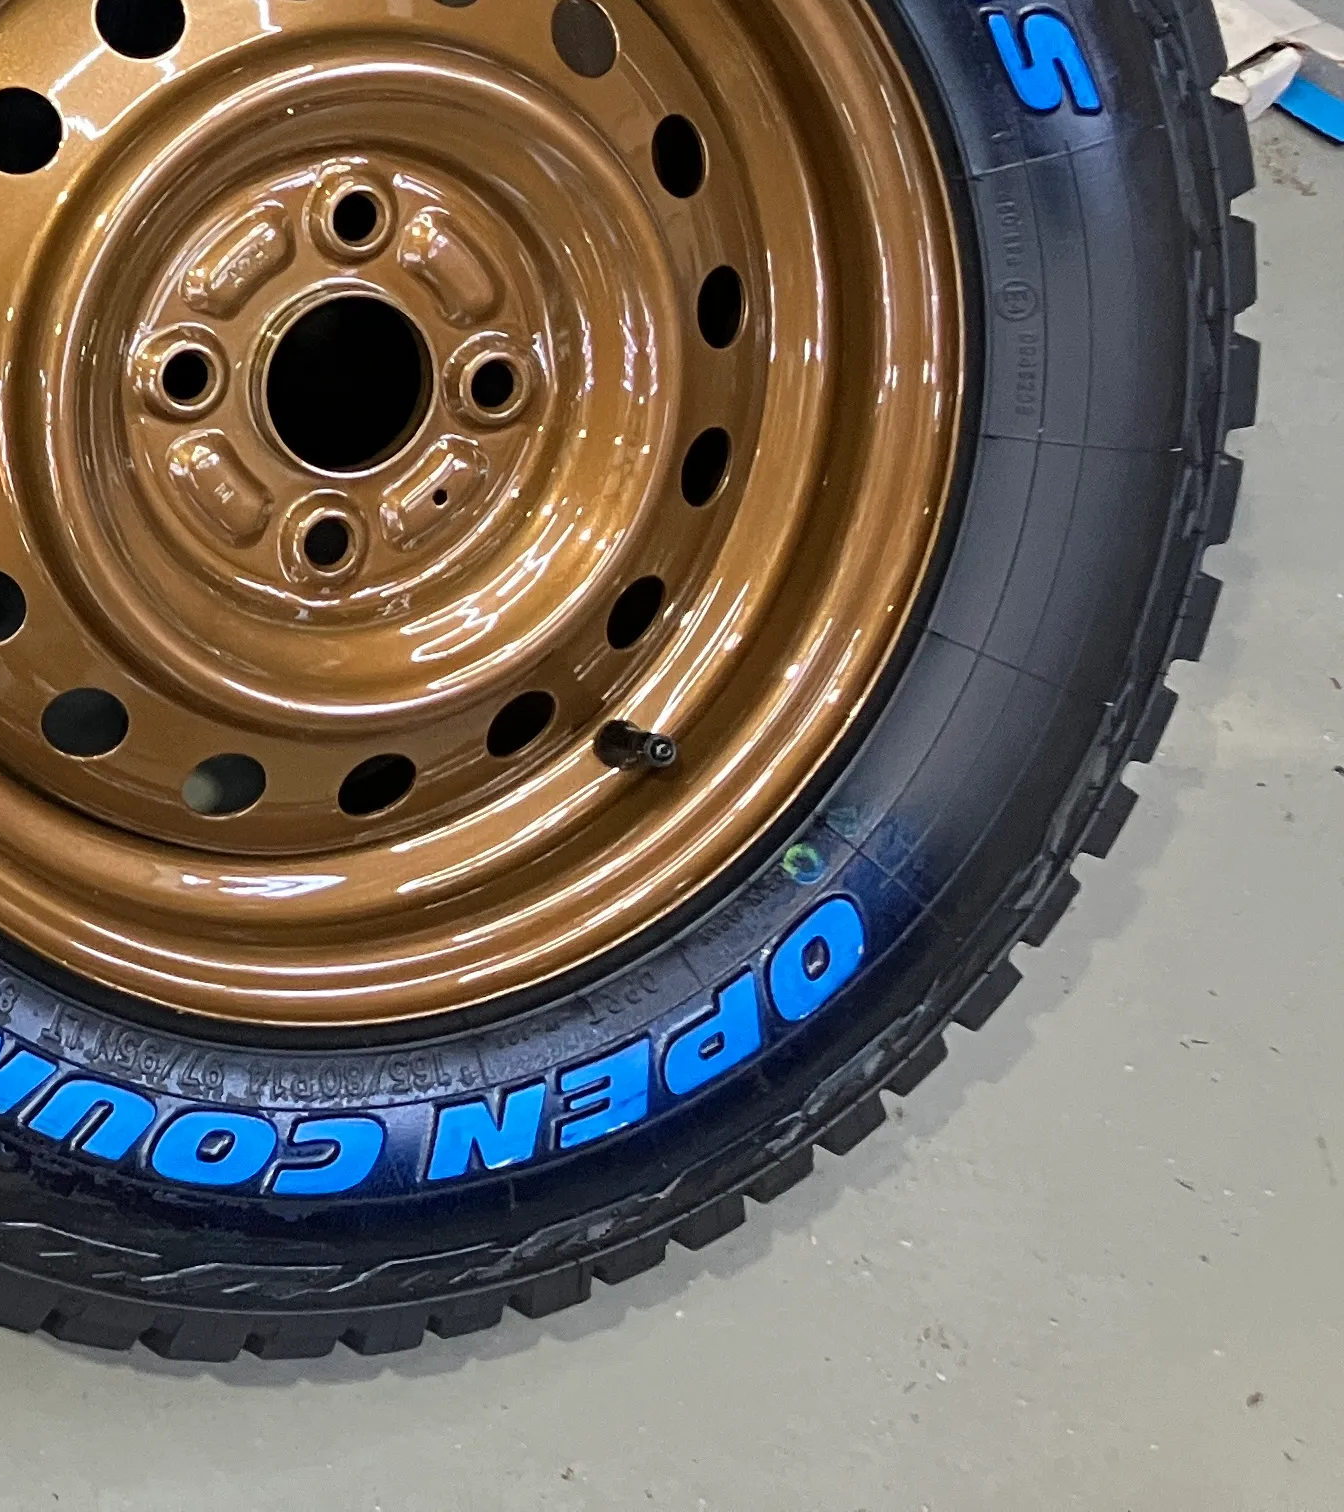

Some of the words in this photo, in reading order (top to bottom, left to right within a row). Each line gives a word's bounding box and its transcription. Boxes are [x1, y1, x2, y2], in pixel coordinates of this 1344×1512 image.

[86, 1016, 231, 1104] 97/95N
[242, 1047, 452, 1109] 165/80R14
[424, 895, 868, 1184] OPEN
